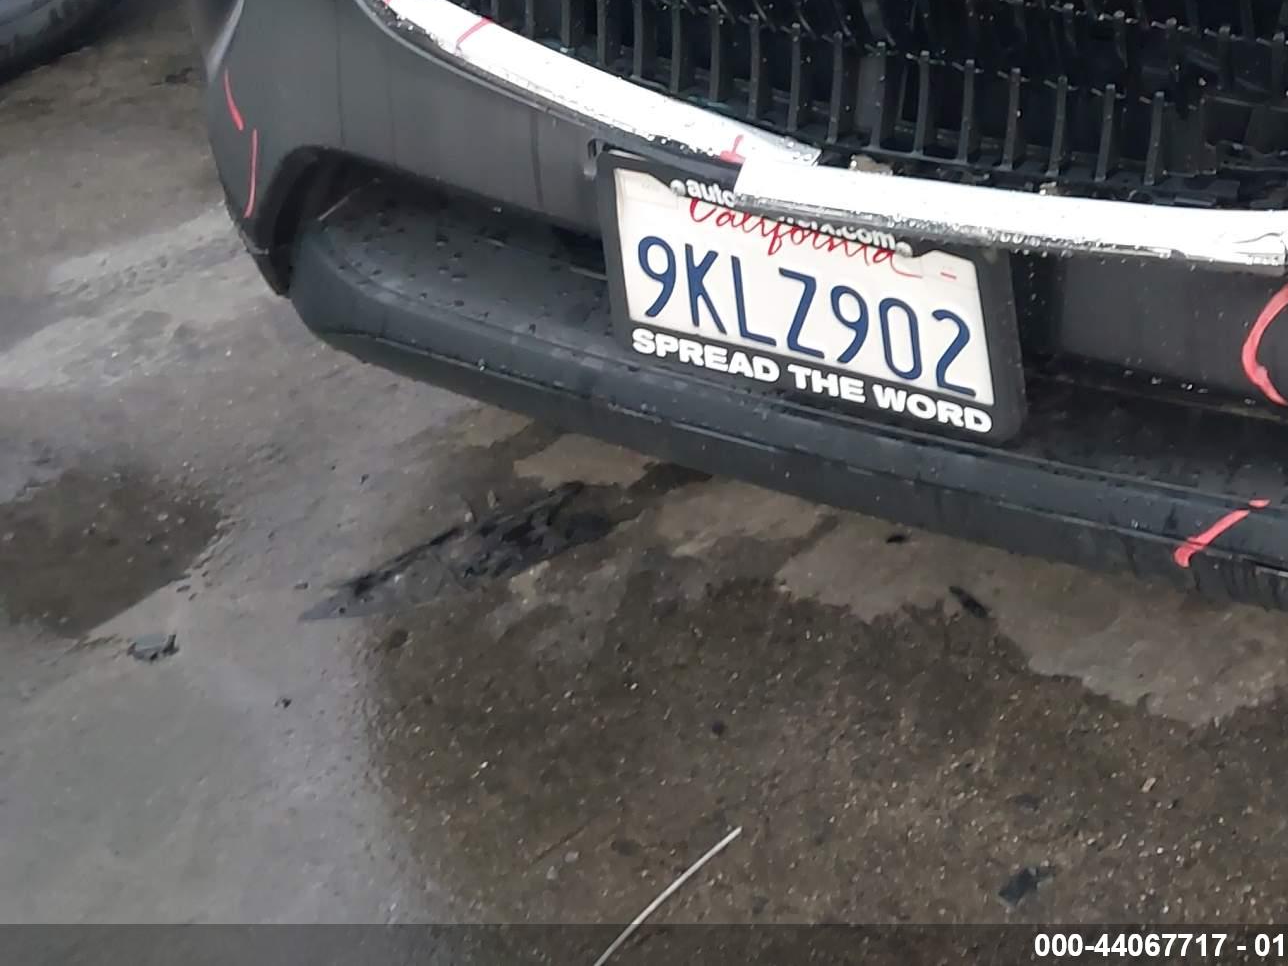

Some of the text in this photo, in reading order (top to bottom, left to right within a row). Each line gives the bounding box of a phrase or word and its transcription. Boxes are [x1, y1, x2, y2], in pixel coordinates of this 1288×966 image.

[632, 328, 993, 434] SPREAD THE WORD
[638, 235, 977, 397] 9KLZ902
